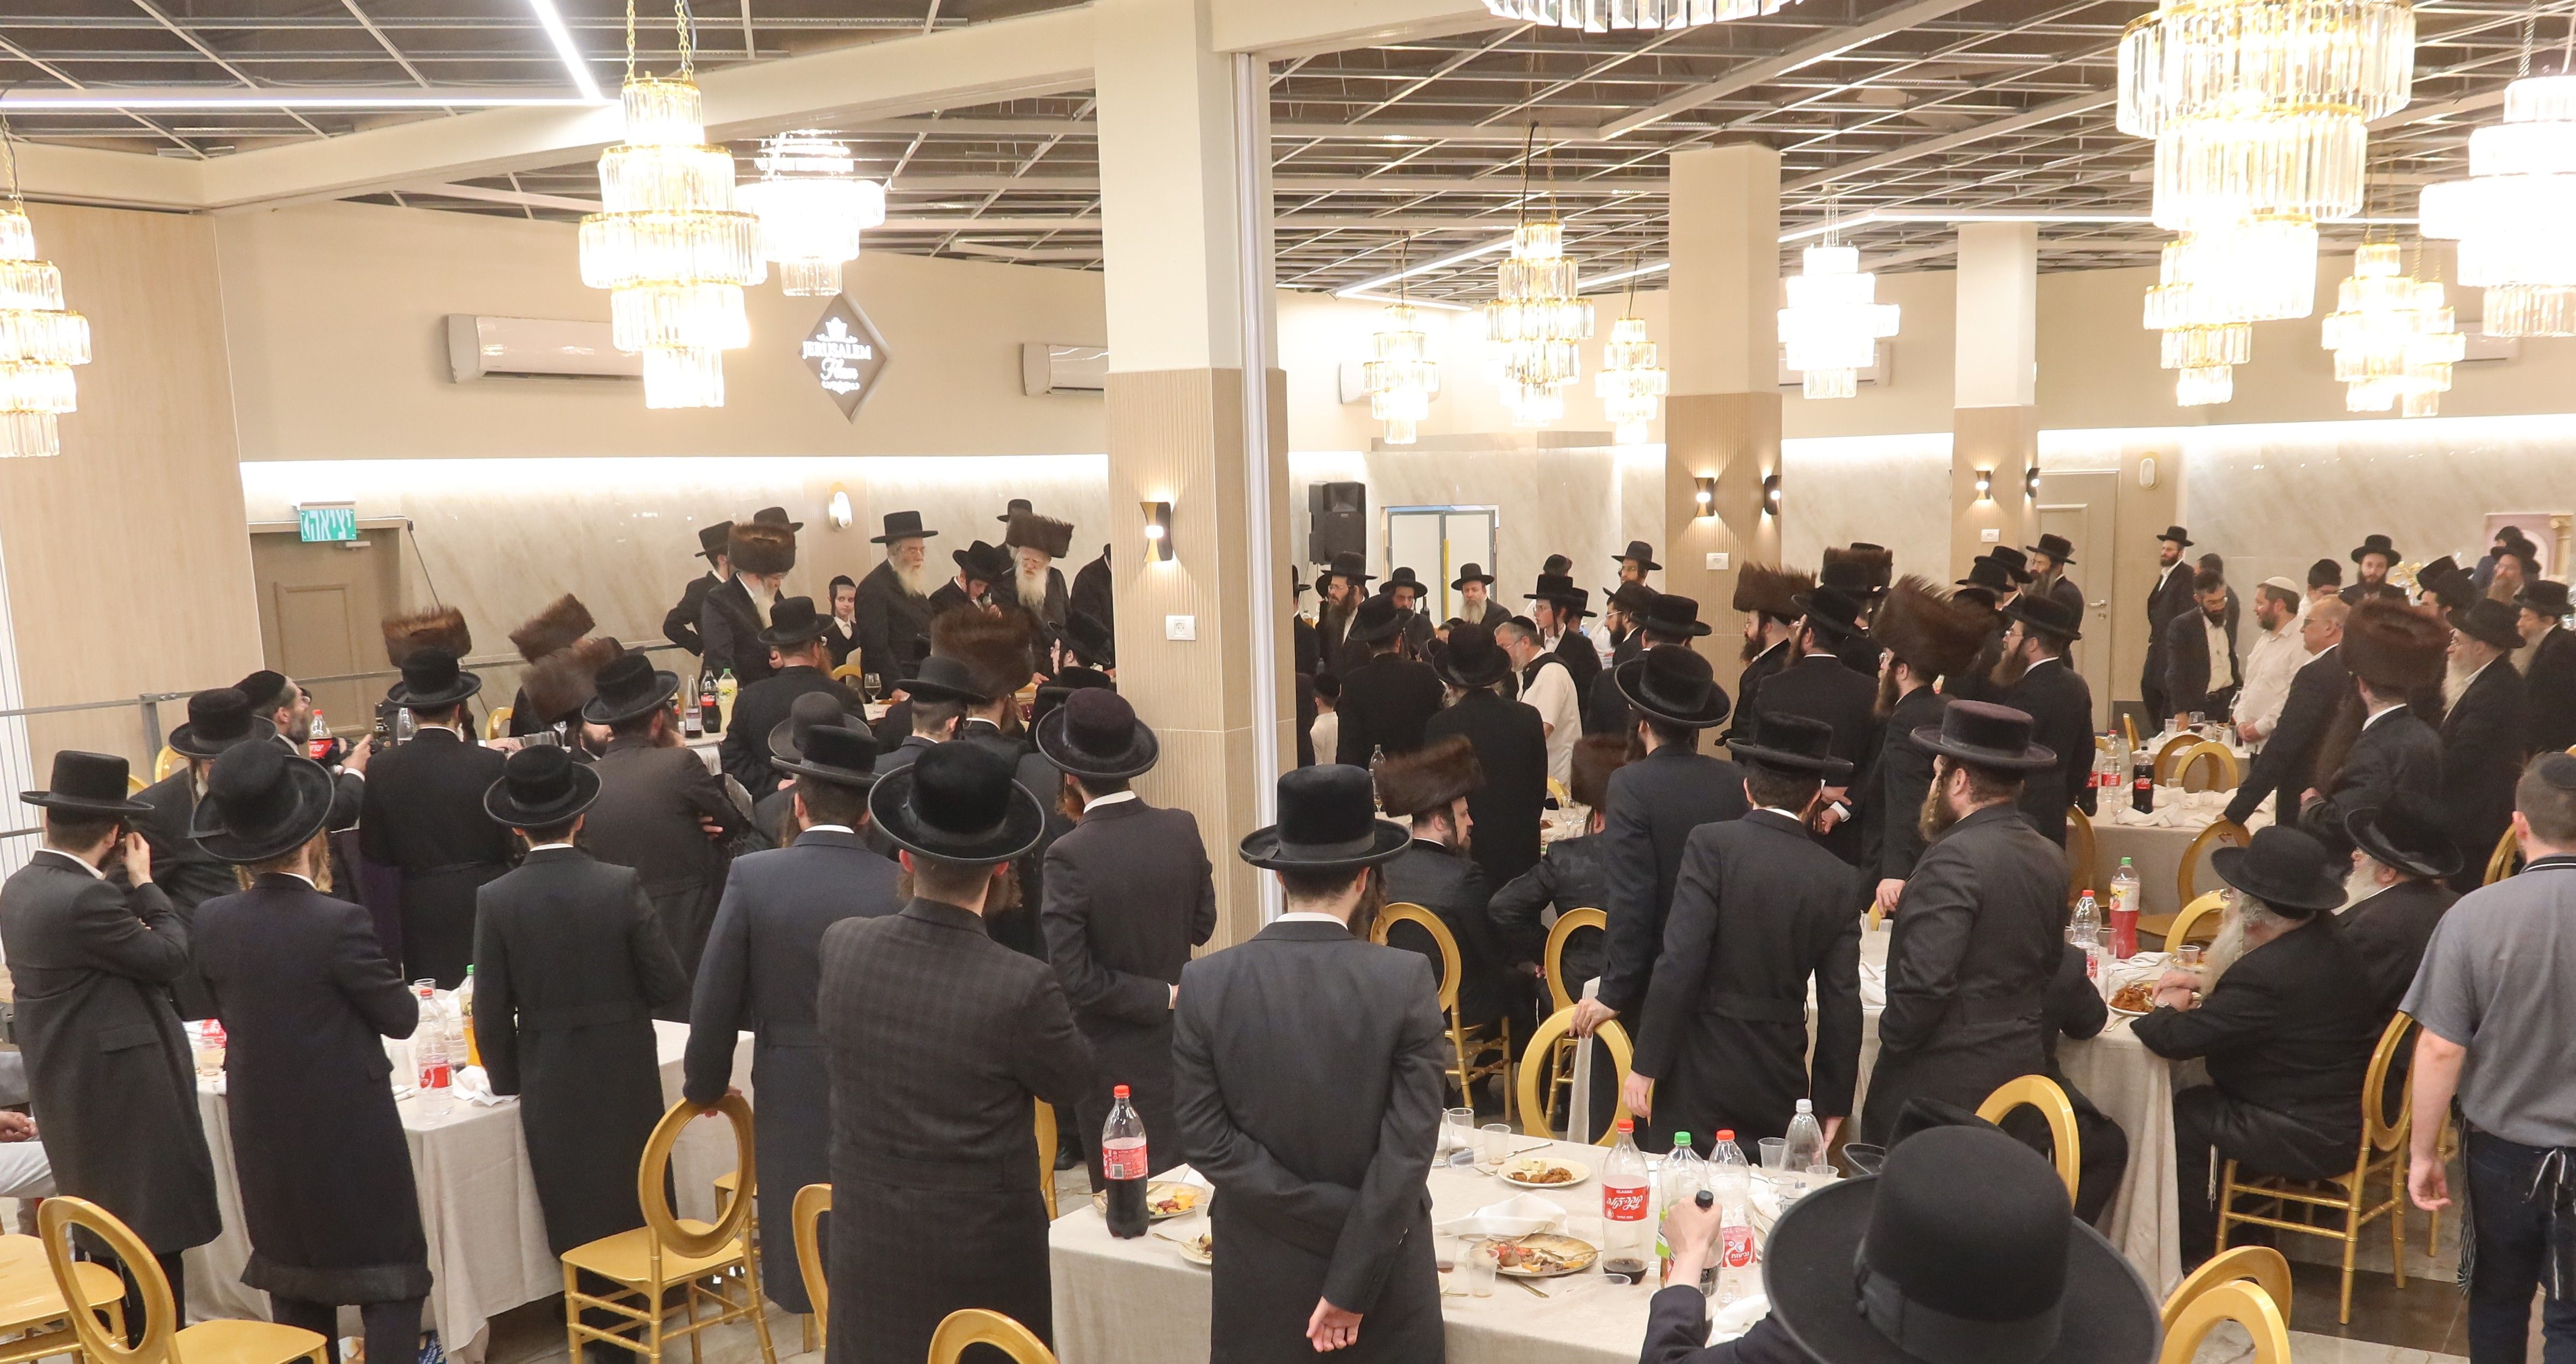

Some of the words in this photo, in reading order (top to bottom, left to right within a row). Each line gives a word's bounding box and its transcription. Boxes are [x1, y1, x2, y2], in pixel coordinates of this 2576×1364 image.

[802, 341, 872, 360] JERUSALEM
[309, 509, 351, 540] יציאה
[1731, 1251, 1749, 1259] נביעות
